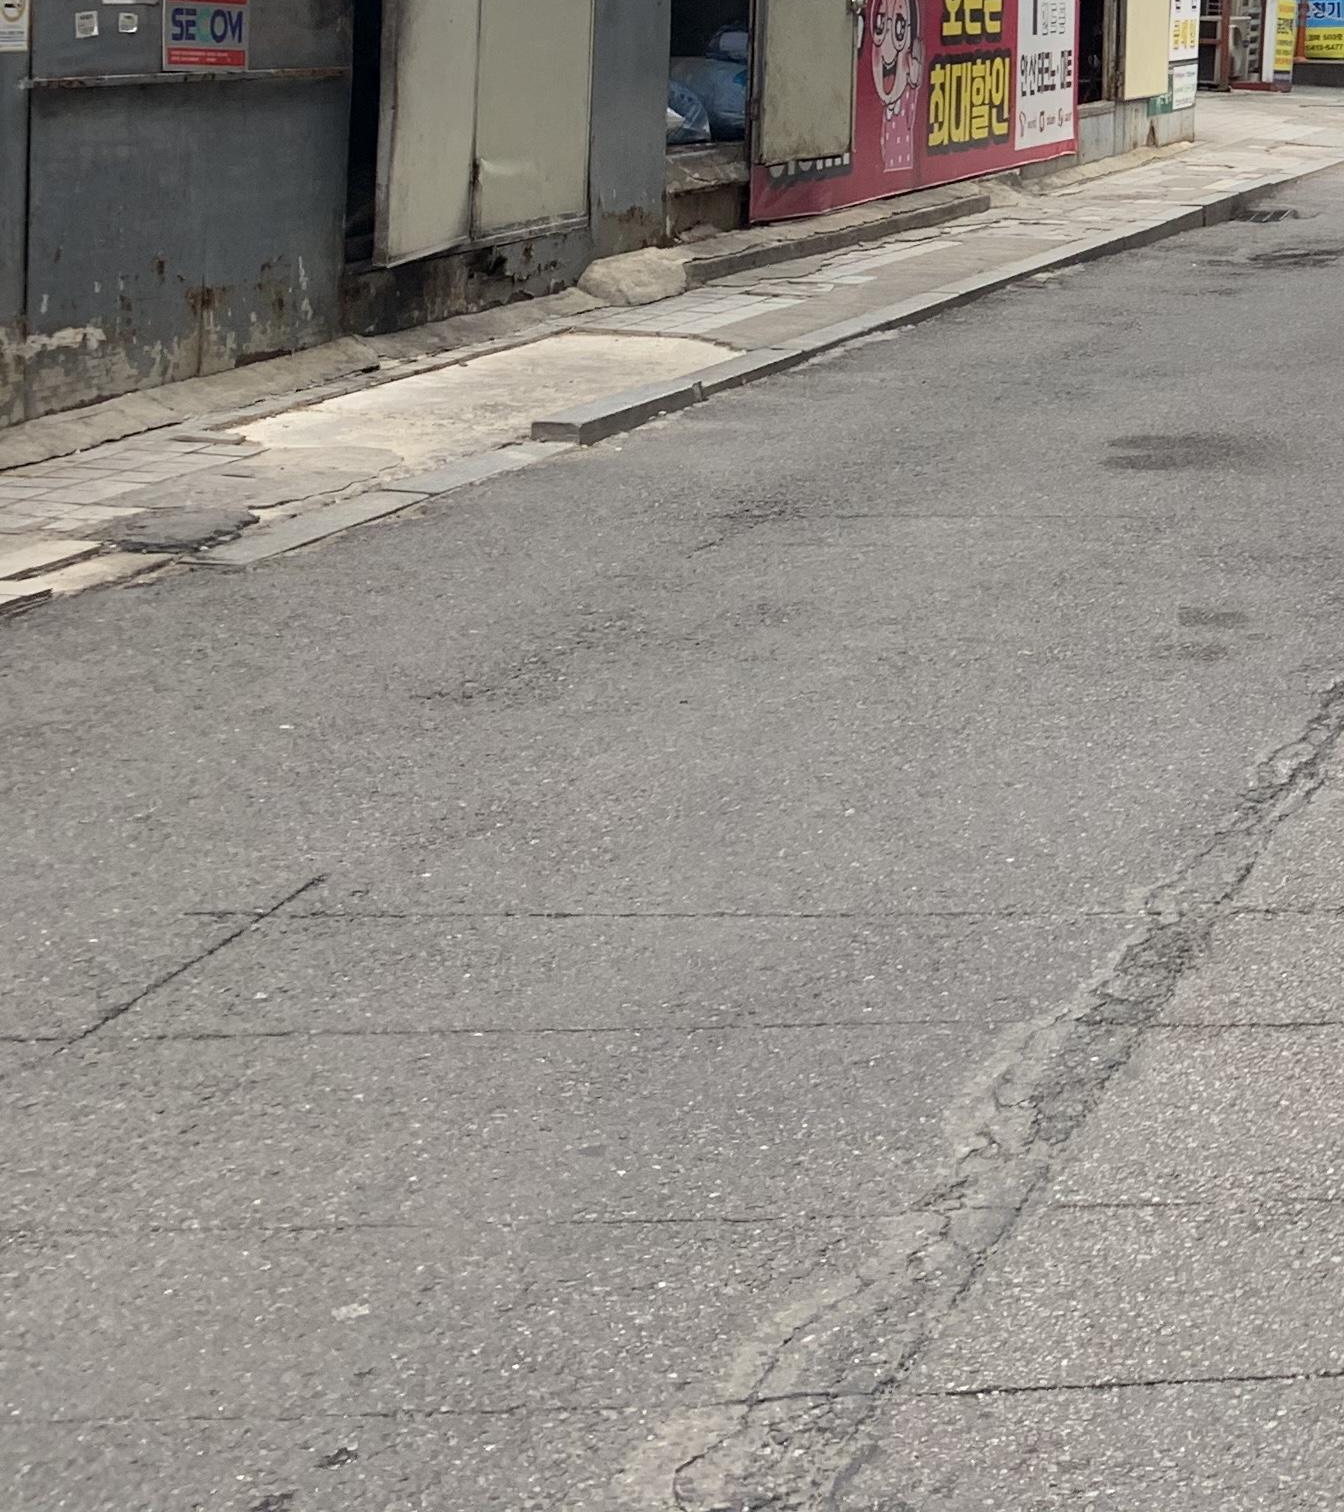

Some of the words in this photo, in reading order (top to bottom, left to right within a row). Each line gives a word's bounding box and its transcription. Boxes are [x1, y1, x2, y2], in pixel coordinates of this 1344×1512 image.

[171, 7, 244, 43] SECOM
[1298, 1, 1341, 19] 청기
[928, 56, 1010, 147] 최대할인
